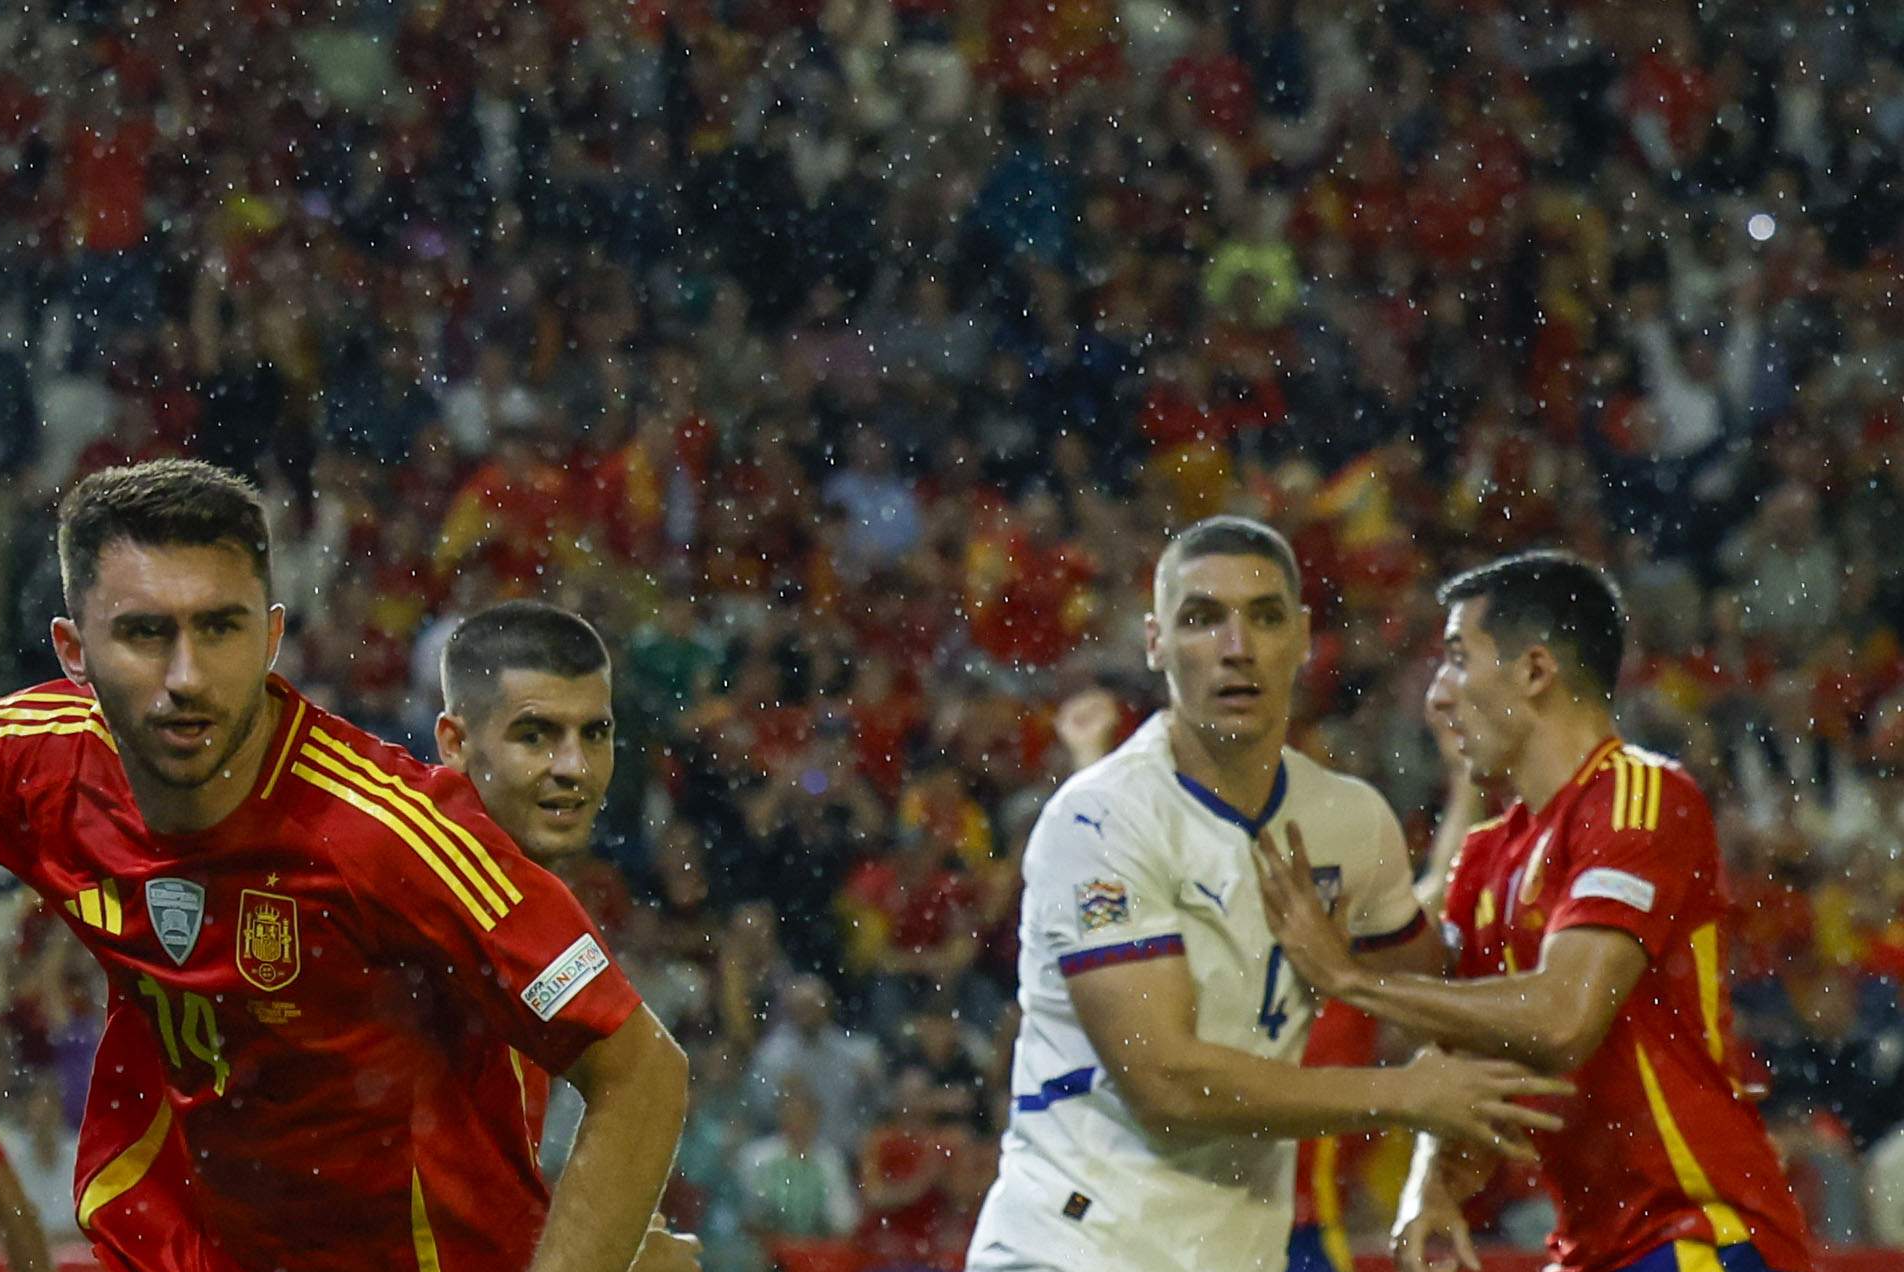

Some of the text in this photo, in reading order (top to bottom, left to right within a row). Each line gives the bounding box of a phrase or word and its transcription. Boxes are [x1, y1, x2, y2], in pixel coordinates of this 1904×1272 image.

[524, 981, 545, 1002] UEFA
[531, 944, 600, 1012] FOUNDATION
[1258, 944, 1289, 1041] 4
[137, 972, 231, 1097] 14
